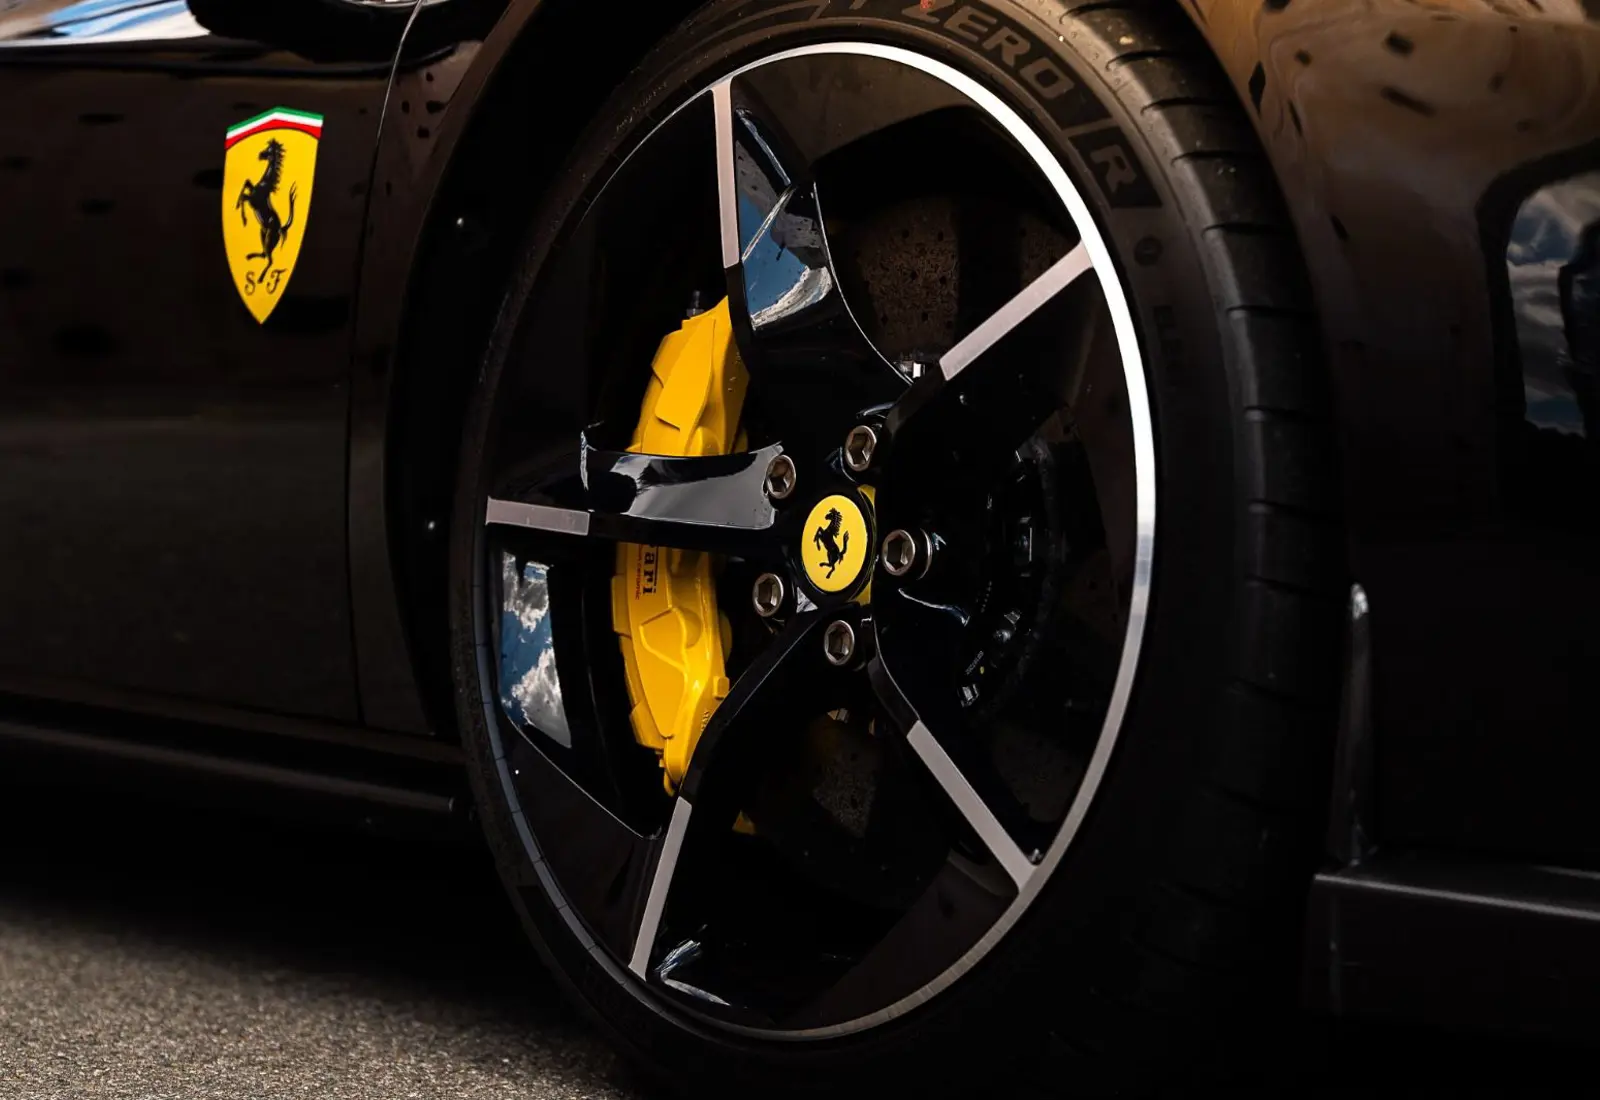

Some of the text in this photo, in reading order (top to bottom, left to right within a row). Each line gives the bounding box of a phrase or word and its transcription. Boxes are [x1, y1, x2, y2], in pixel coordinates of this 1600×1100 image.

[1090, 144, 1138, 194] R
[244, 268, 287, 296] S F
